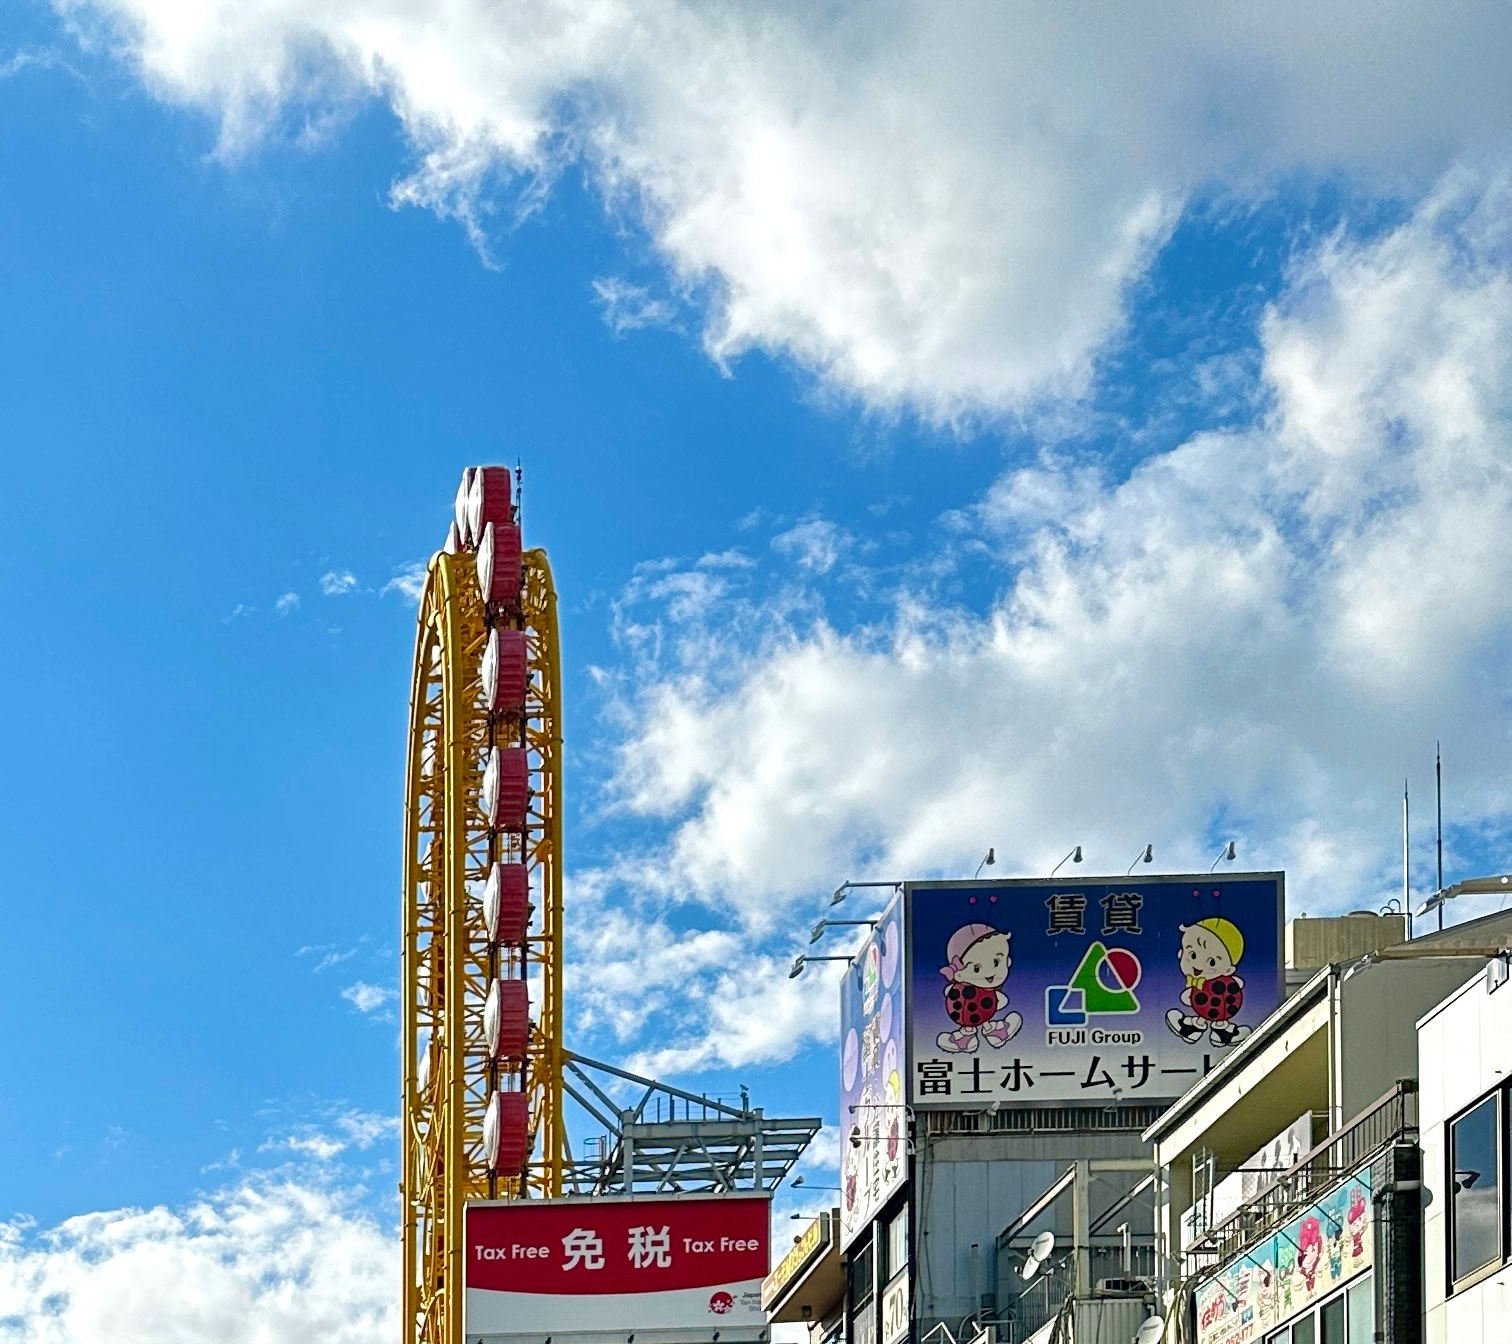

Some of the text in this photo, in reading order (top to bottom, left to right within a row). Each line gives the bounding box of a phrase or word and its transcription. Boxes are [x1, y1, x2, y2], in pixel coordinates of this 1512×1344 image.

[1044, 893, 1145, 936] 賃貸
[1048, 1030, 1142, 1045] FUJI Group
[475, 1244, 551, 1260] Tax Free
[561, 1225, 673, 1271] 免税
[682, 1236, 760, 1253] Tax Free
